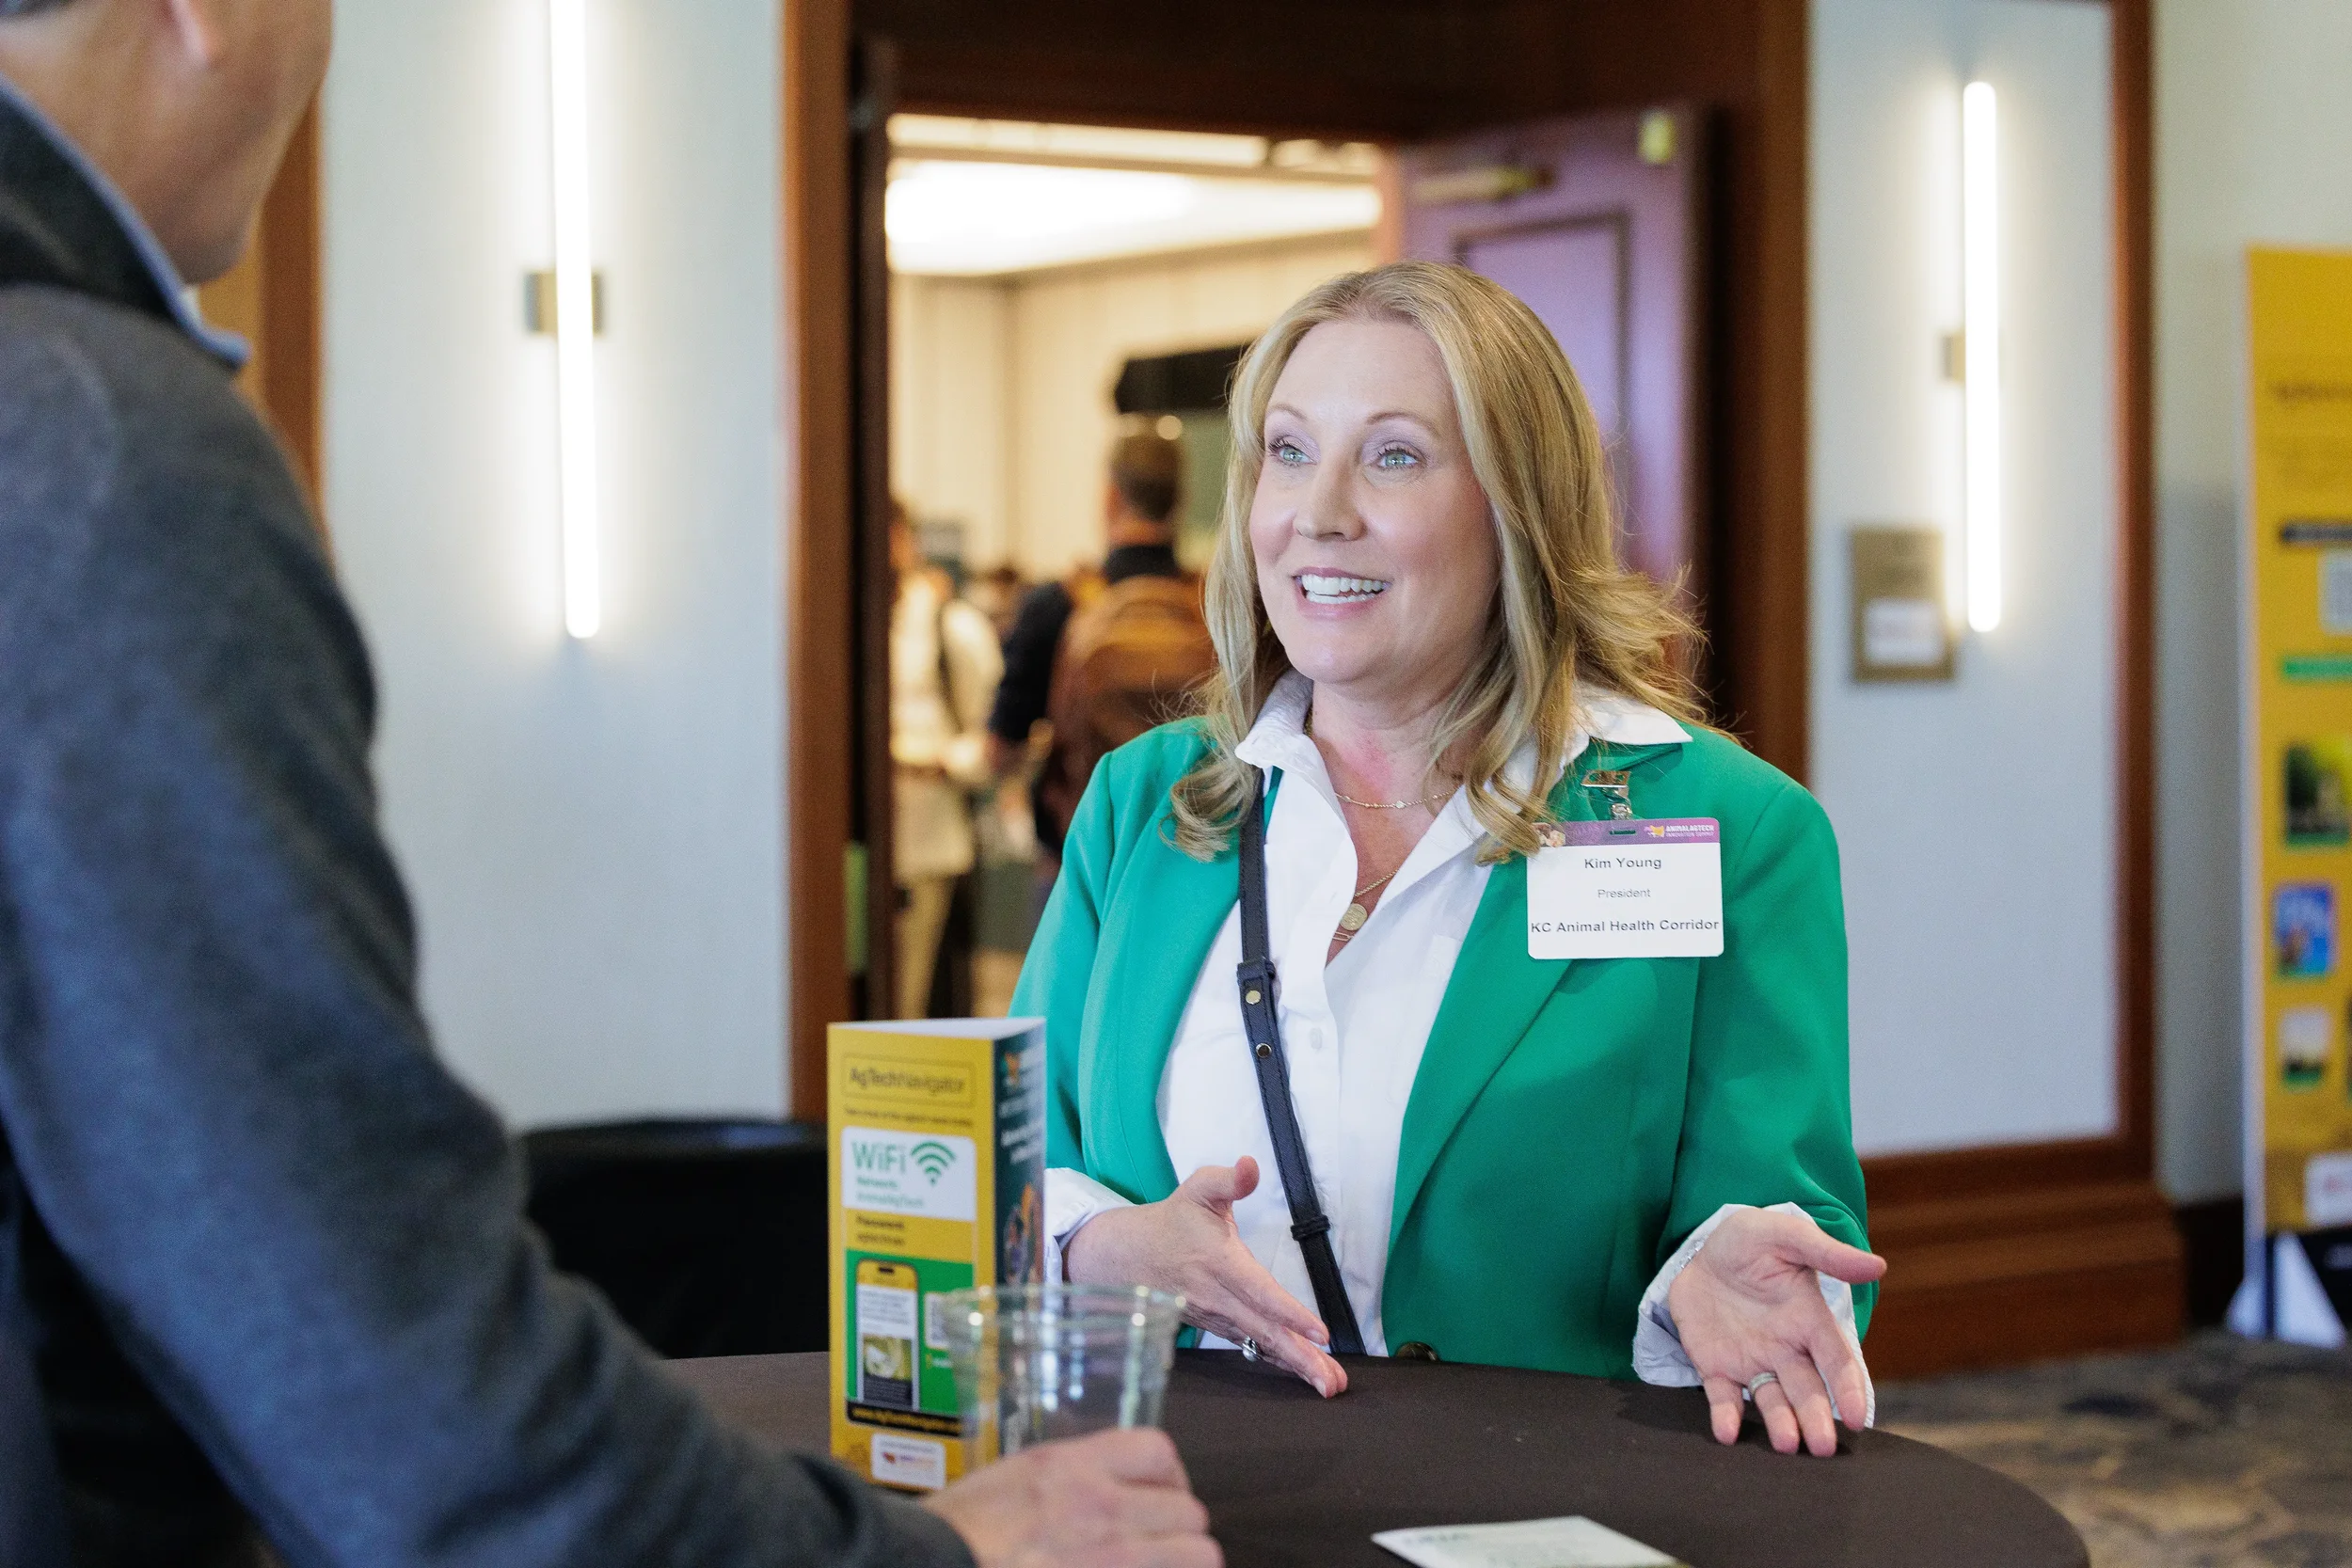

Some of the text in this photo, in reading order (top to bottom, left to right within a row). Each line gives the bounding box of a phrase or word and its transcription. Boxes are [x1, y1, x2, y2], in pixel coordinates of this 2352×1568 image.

[1584, 858, 1662, 870] Kim Young
[1597, 888, 1651, 899] President
[1531, 919, 1720, 933] KC Animal Health Corridor
[851, 1141, 906, 1173] WiFi
